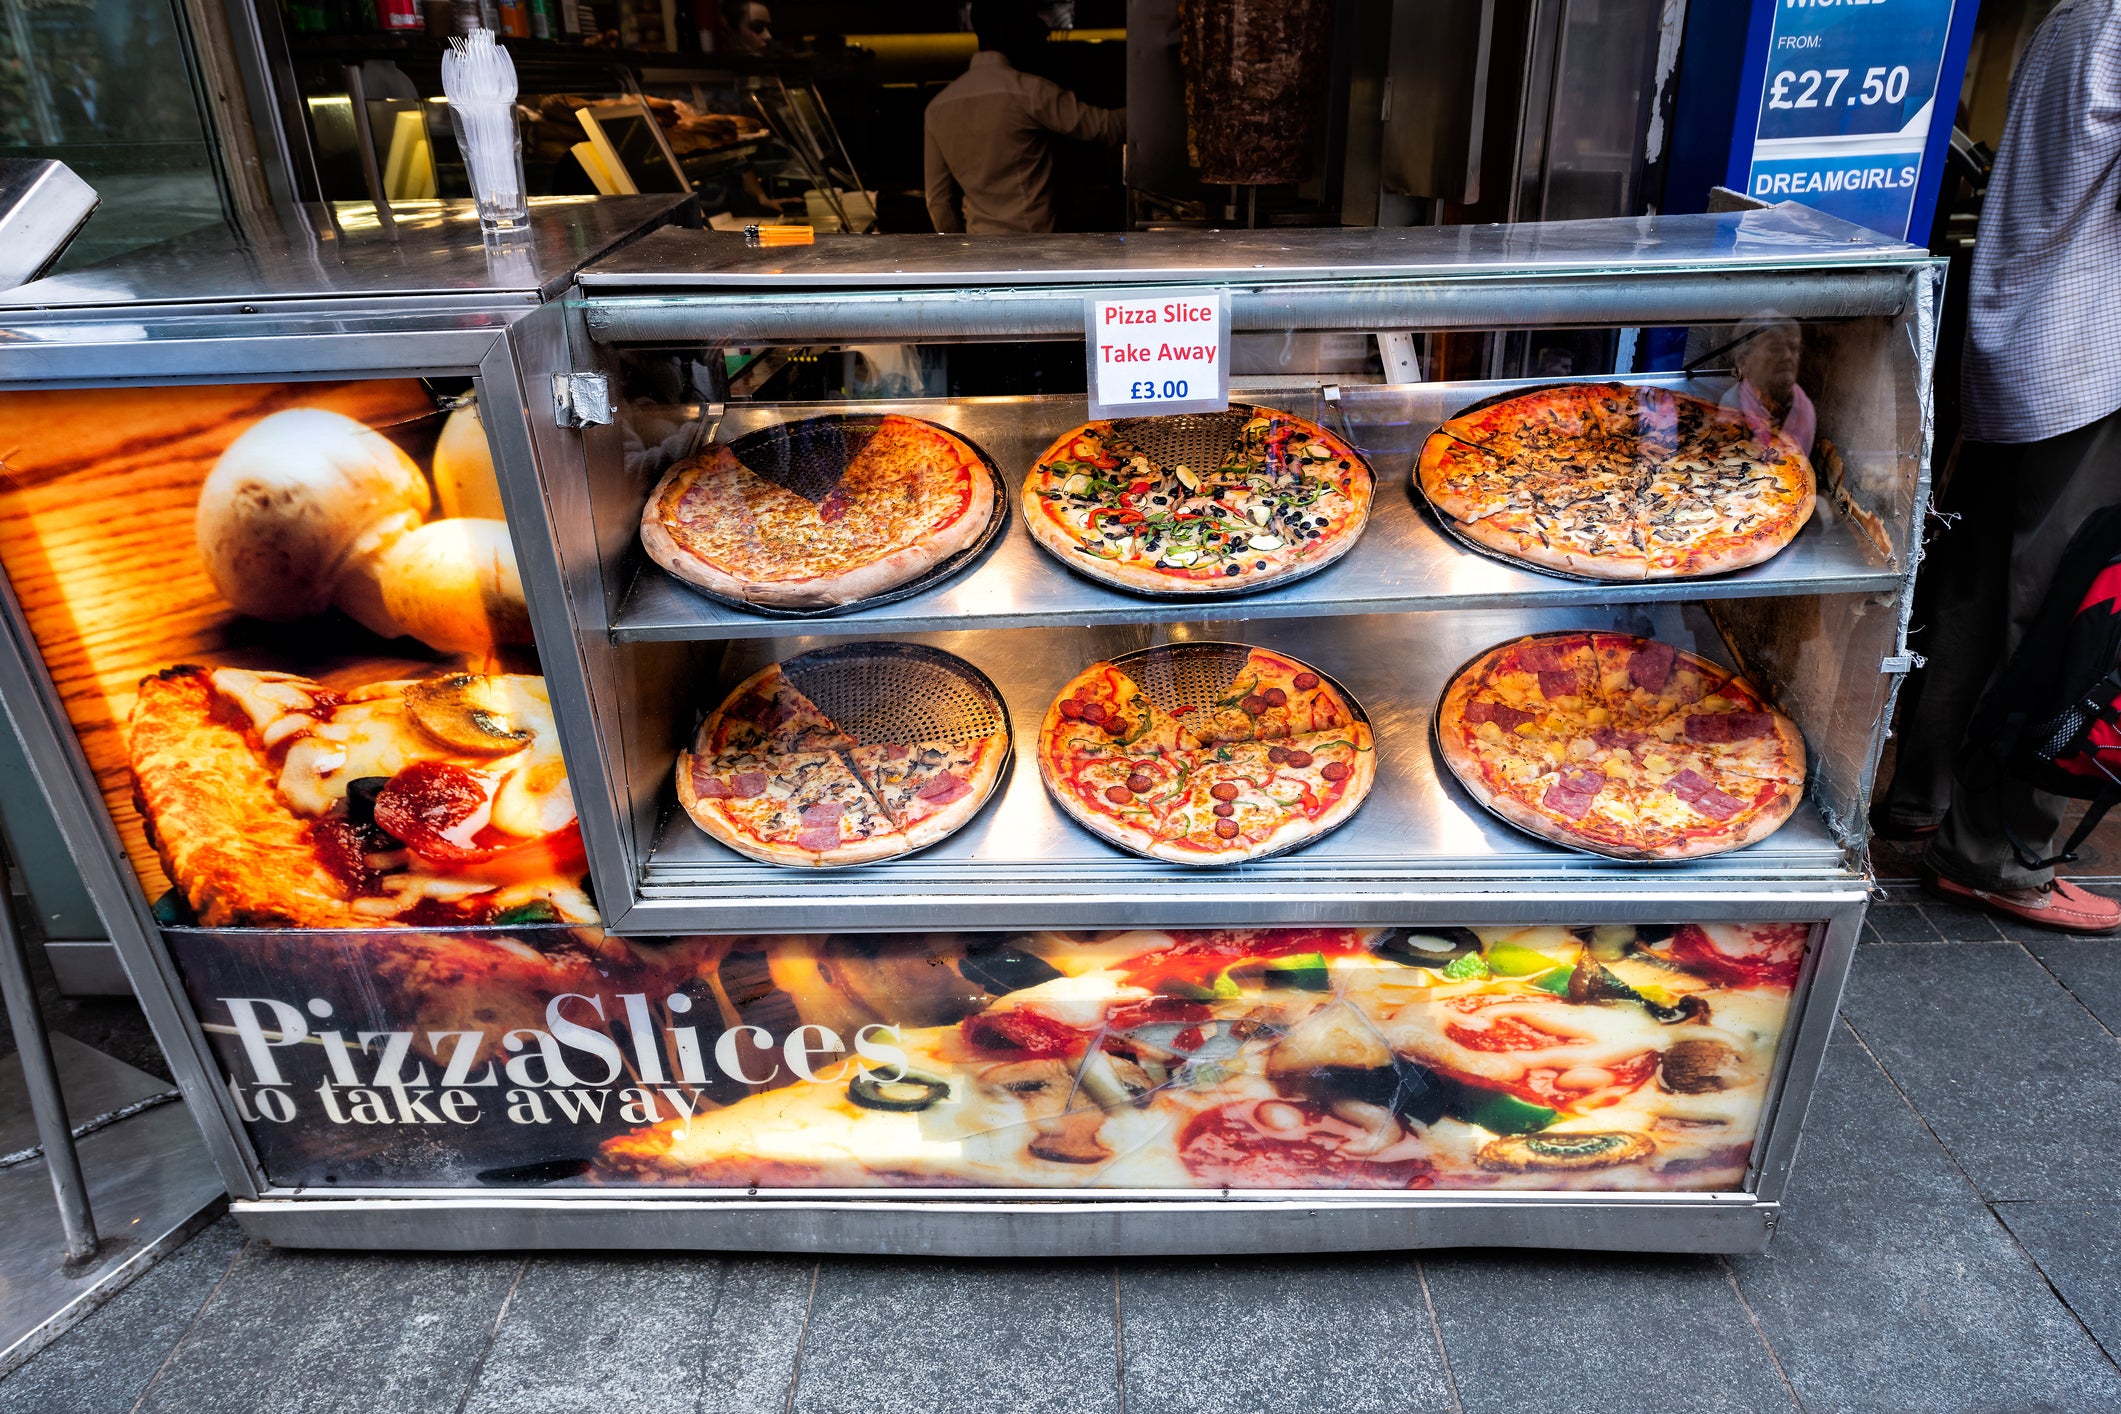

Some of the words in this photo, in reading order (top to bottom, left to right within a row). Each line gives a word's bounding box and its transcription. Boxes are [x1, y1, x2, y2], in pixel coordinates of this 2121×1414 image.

[1777, 35, 1822, 50] FROM:
[1768, 65, 1910, 111] £27.50
[1755, 166, 1917, 196] DREAMGIRLS
[1105, 305, 1157, 325] Pizza
[1163, 303, 1212, 324] Slice
[1100, 343, 1151, 363] Take
[1157, 343, 1217, 364] Away
[1130, 380, 1189, 400] £3.00
[228, 1072, 297, 1124] to
[314, 1070, 482, 1124] take
[506, 1085, 702, 1140] away
